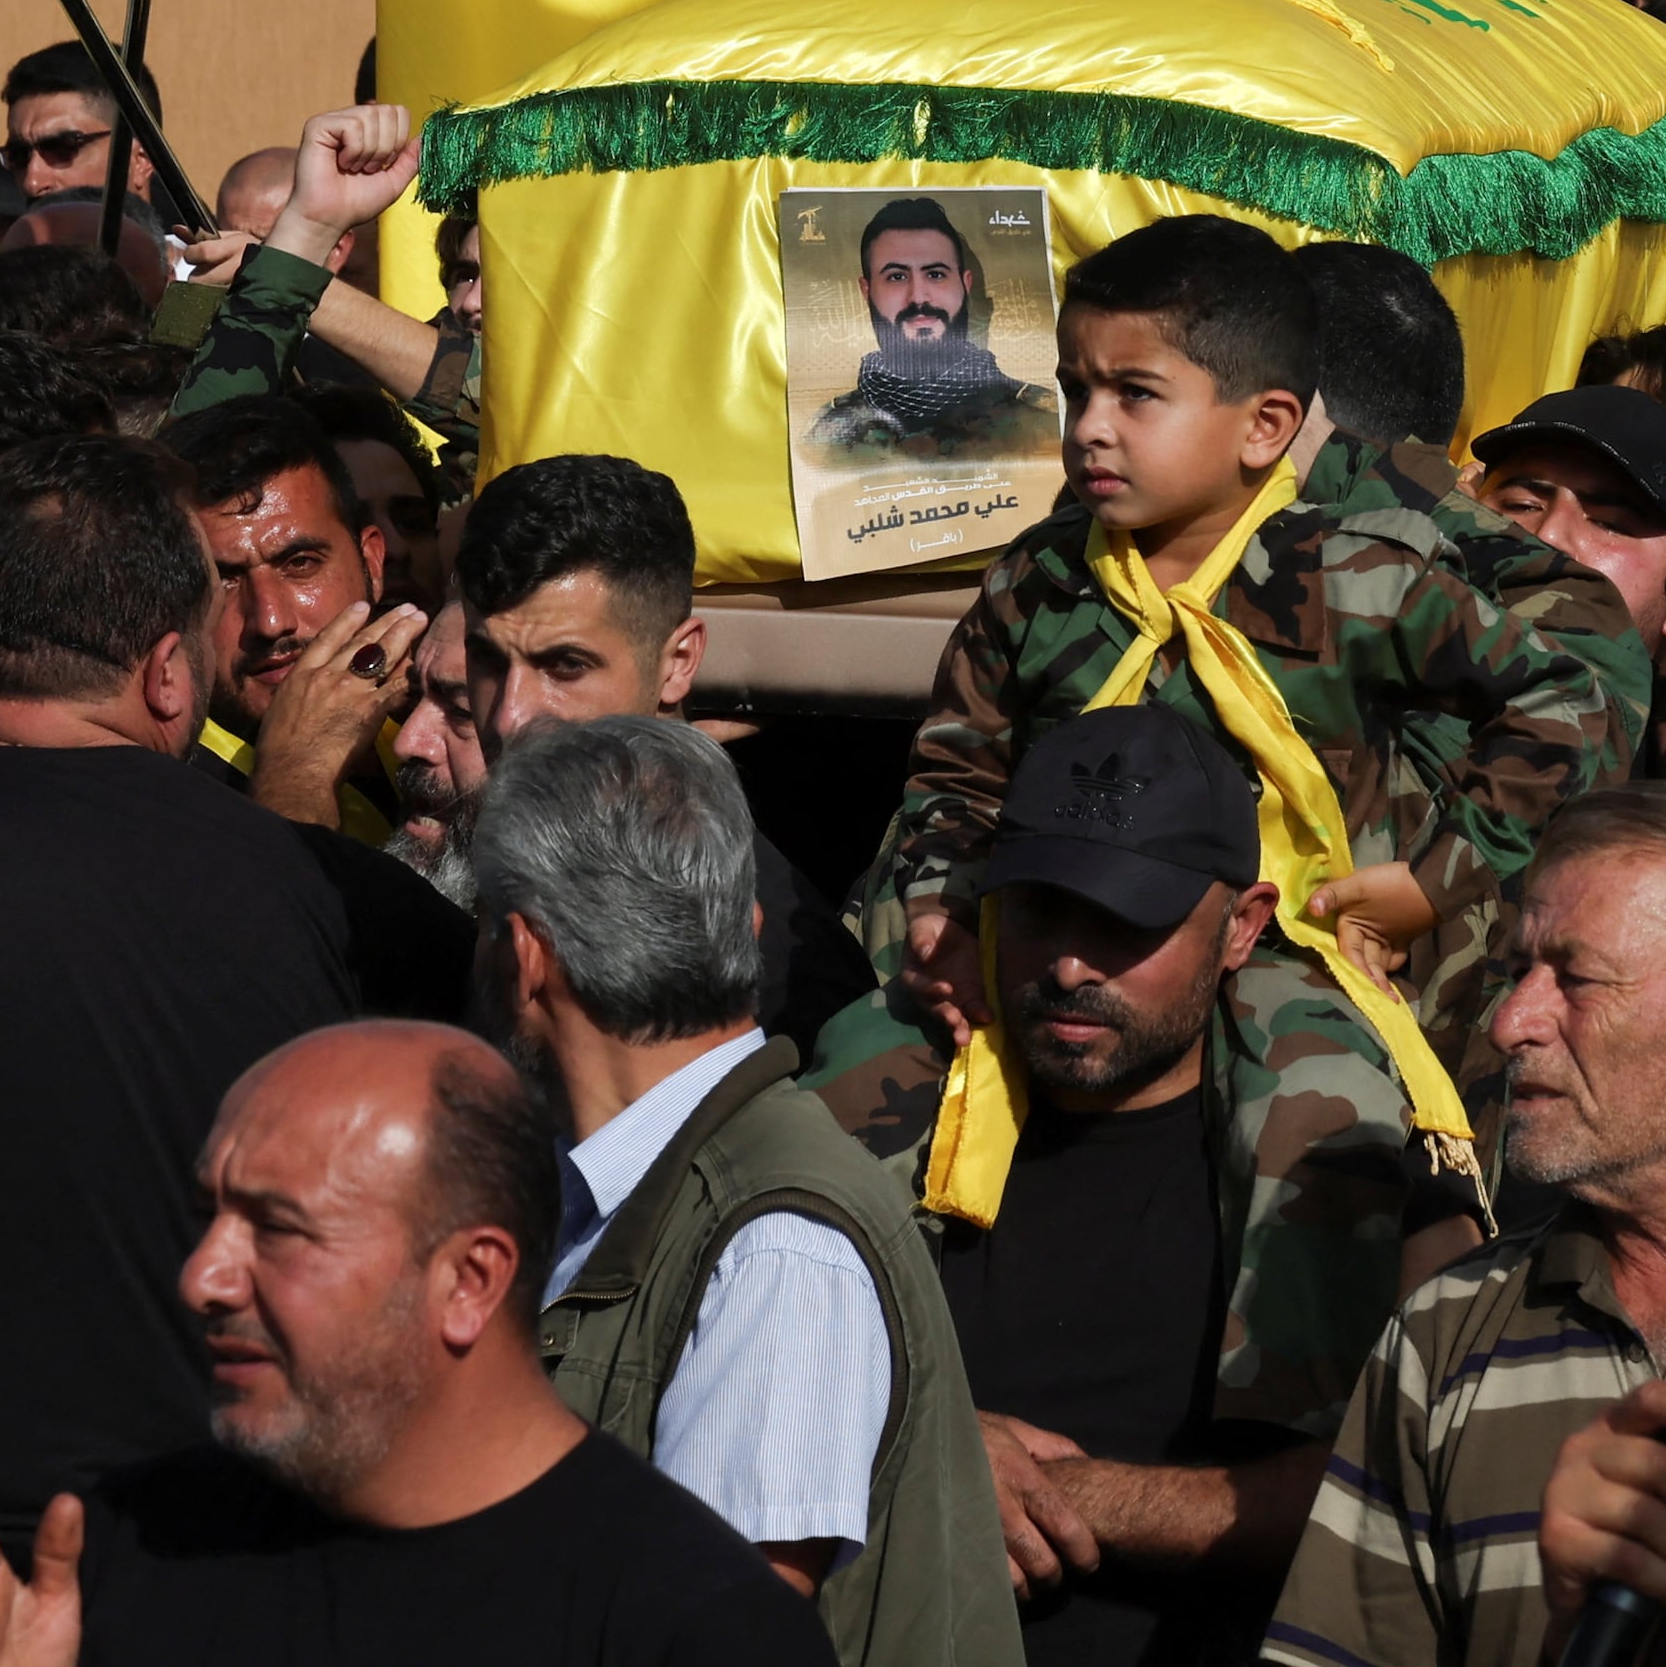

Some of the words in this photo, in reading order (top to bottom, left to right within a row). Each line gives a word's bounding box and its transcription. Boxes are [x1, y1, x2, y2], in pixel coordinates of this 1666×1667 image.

[909, 501, 971, 526] محمد
[974, 492, 1020, 519] علي
[846, 504, 905, 545] شلبي
